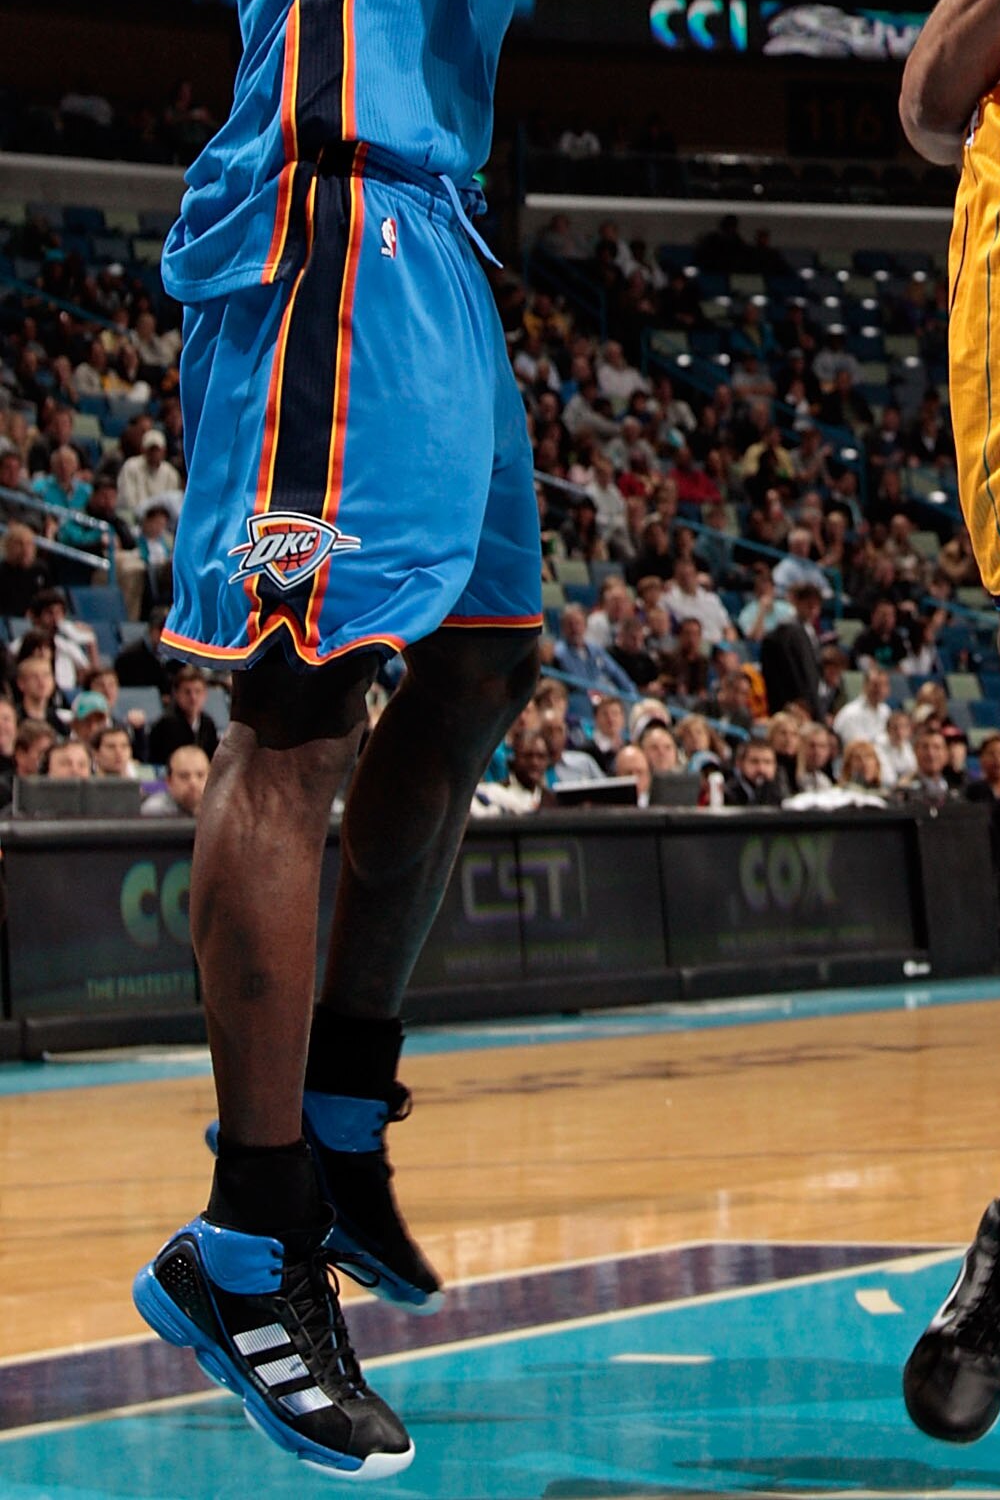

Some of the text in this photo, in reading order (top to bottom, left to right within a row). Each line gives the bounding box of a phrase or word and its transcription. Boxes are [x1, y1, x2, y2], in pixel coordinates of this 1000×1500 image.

[244, 530, 319, 570] OKC
[462, 850, 571, 922] CST
[739, 833, 838, 910] COX
